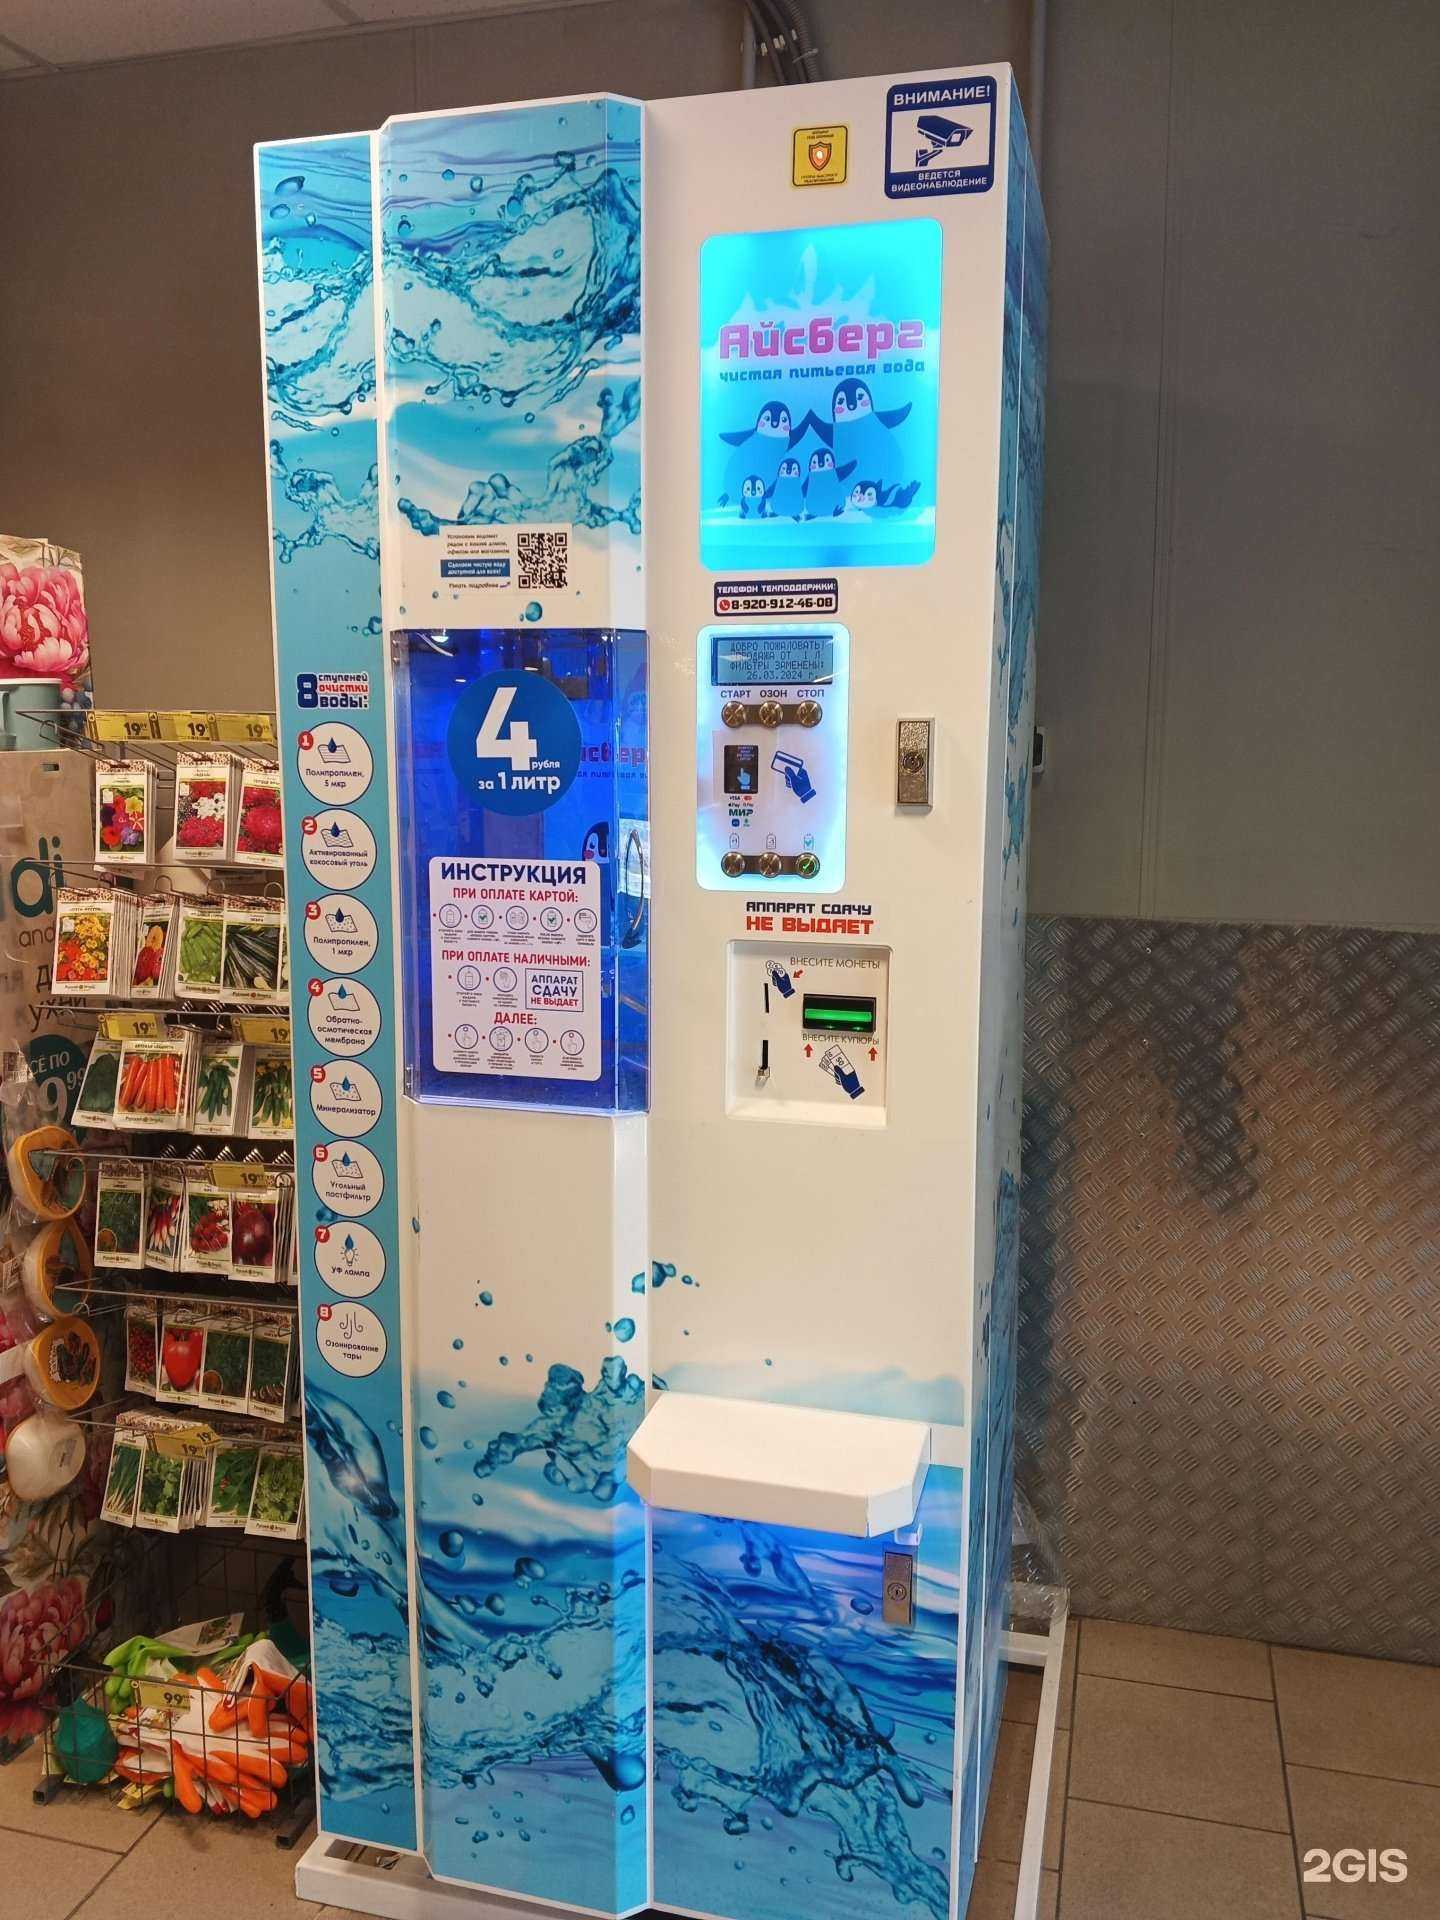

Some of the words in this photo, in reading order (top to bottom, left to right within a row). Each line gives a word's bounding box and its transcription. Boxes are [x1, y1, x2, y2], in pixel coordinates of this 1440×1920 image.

[893, 85, 990, 106] ВНИМАНИЕ!
[918, 169, 961, 181] ВЕДЕТСЯ
[891, 177, 987, 192] ВИДЕОНАБЛЮДЕНИЕ
[718, 317, 924, 360] Айсберг
[719, 368, 783, 383] чистая
[789, 362, 876, 379] питьевая
[883, 359, 926, 374] вода
[717, 585, 759, 594] ТЕЛЕФОН
[730, 641, 758, 651] ДОБРО
[780, 651, 791, 660] ОТ
[729, 661, 770, 671] ФИЛЬТРЫ
[747, 670, 802, 681] 26.03.2024
[297, 673, 318, 708] 8
[318, 672, 368, 684] ступеней
[319, 683, 369, 693] очистки
[720, 689, 751, 699] СТАРТ
[760, 689, 788, 698] ОЗОН
[797, 688, 825, 698] СТОП
[319, 692, 368, 709] воды:
[123, 722, 141, 736] 19
[187, 722, 206, 737] 19
[246, 723, 264, 737] 19
[476, 687, 538, 771] 4
[301, 734, 310, 746] 1
[532, 760, 560, 770] рубля
[331, 780, 346, 789] мкр
[478, 779, 494, 790] за
[498, 772, 507, 790] 1
[511, 775, 561, 794] литр
[728, 808, 754, 817] МИР
[303, 819, 314, 832] 2
[309, 849, 368, 858] Активированный
[309, 859, 348, 867] кокосовый
[349, 860, 368, 868] уголь
[441, 862, 586, 887] ИНСТРУКЦИЯ
[453, 887, 476, 899] ПРИ
[480, 888, 525, 901] ОПЛАТЕ
[529, 889, 578, 903] КАРТОЙ:
[308, 904, 318, 917] 3
[746, 901, 815, 914] АППАРАТ
[821, 903, 872, 915] СДАЧУ
[746, 916, 774, 931] НЕ
[782, 917, 874, 935] ВЫДАЕТ
[313, 936, 371, 947] Полипропилен,
[338, 948, 353, 957] мкр
[441, 949, 464, 961] ПРИ
[467, 950, 510, 963] ОПЛАТЕ
[513, 953, 591, 967] НАЛИЧНЫМИ:
[790, 957, 833, 968] ВНЕСИТЕ
[835, 958, 880, 969] МОНЕТЫ
[531, 974, 578, 985] АППАРАТ
[310, 980, 320, 993] 4
[532, 984, 577, 998] СДАЧУ
[530, 997, 542, 1005] НЕ
[543, 998, 579, 1007] ВЫДАЕТ
[325, 1015, 363, 1025] Обратно-
[493, 1012, 538, 1025] ДАЛЕЕ:
[132, 1022, 150, 1035] 19
[271, 1028, 288, 1041] 19
[317, 1026, 372, 1036] осмотическая
[325, 1036, 366, 1046] мембрана
[802, 1032, 840, 1042] ВНЕСИТЕ
[841, 1035, 880, 1045] КУПЮРЫ
[313, 1068, 323, 1080] 5
[317, 1103, 376, 1117] Минерализатор
[315, 1147, 325, 1159] 6
[240, 1172, 258, 1185] 19
[330, 1181, 366, 1191] Угольный
[325, 1191, 371, 1202] постфильтр
[318, 1228, 327, 1240] 7
[331, 1266, 343, 1274] УФ
[344, 1269, 370, 1278] лампа
[320, 1306, 329, 1318] 8
[325, 1339, 379, 1352] Озонирование
[343, 1352, 362, 1360] тары
[164, 1692, 183, 1706] 99
